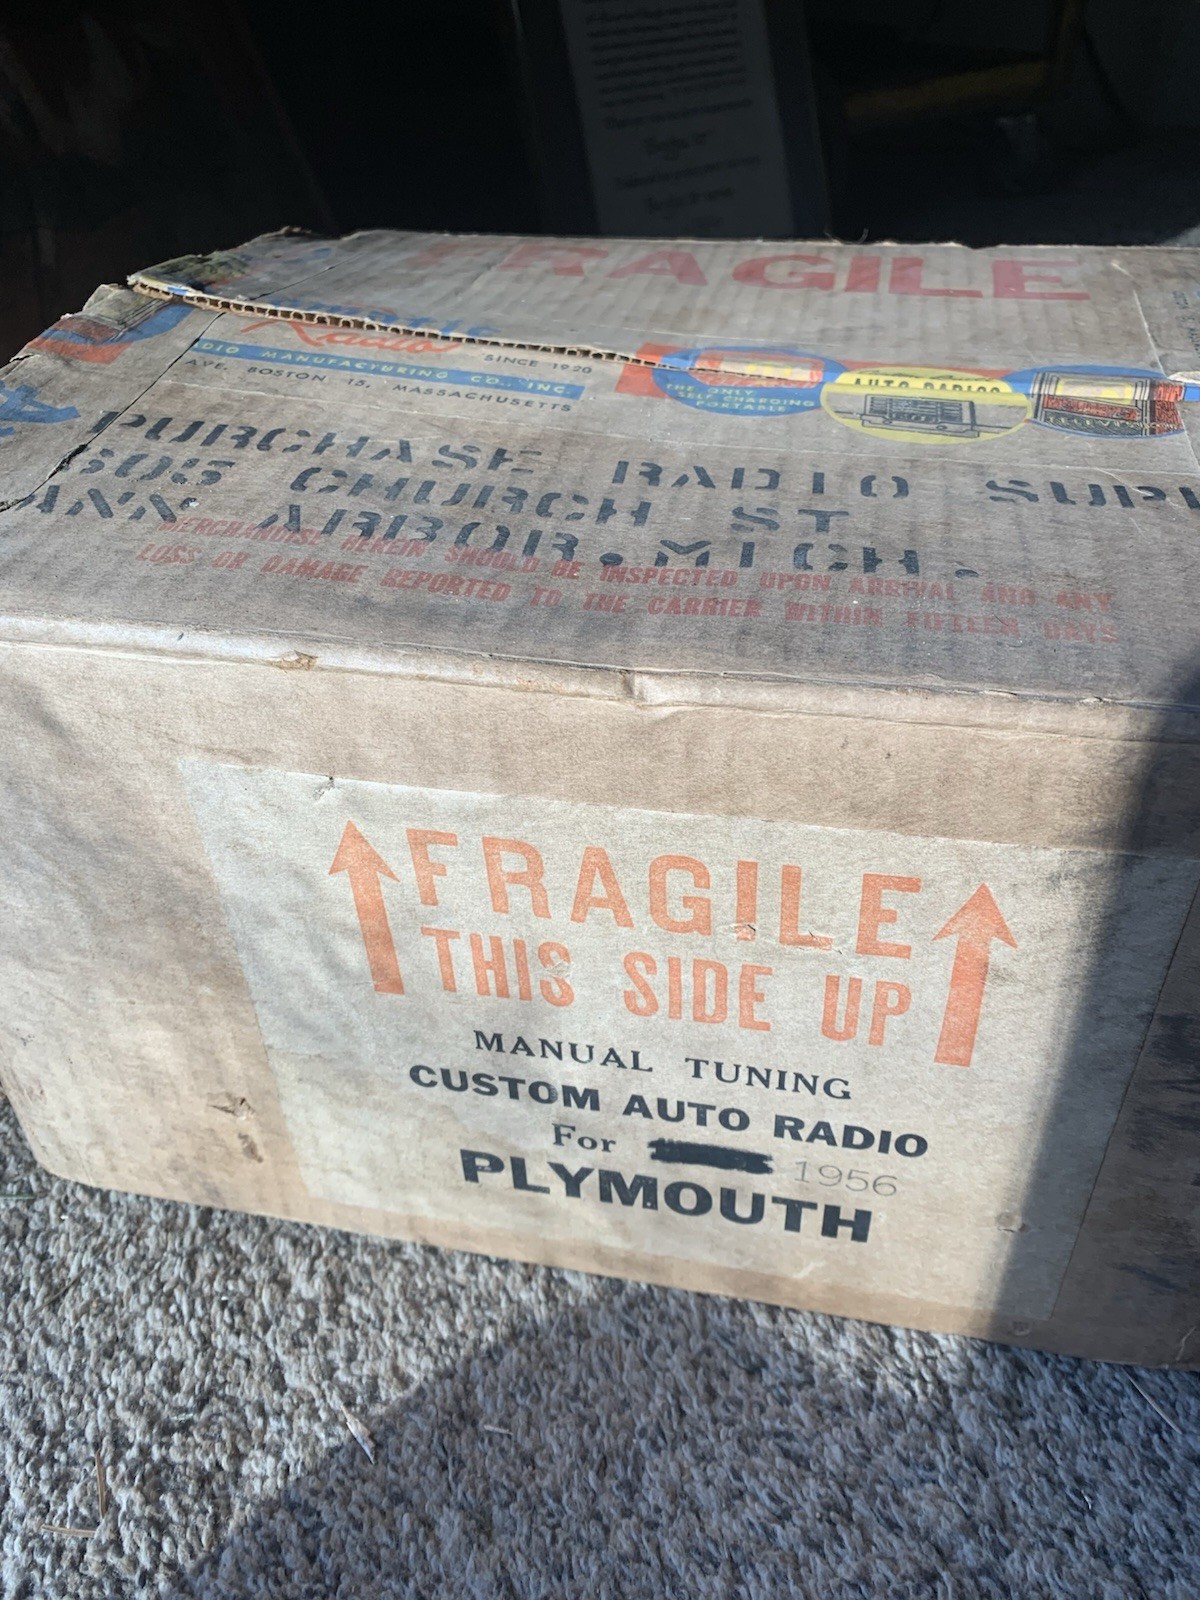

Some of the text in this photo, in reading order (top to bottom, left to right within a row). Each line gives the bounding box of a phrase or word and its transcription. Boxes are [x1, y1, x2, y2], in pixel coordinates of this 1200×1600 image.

[404, 242, 1091, 301] FRAGILE
[185, 358, 228, 371] AVE.
[247, 366, 327, 383] BOSTON
[392, 384, 573, 413] MASSACHUSETTS
[260, 350, 449, 379] MANUFACTURING
[484, 353, 593, 375] SINCE 1920
[666, 383, 755, 396] THE ONLY
[678, 391, 714, 400] SELF
[695, 400, 787, 413] PORTABLE
[87, 411, 542, 474] PURCHASE
[611, 460, 910, 499] RADIO
[289, 466, 652, 526] CHURCH
[730, 505, 850, 533] ST
[135, 542, 201, 566] LOSS
[211, 550, 252, 570] OR
[260, 554, 369, 584] DAMAGE
[379, 566, 512, 603] REPORTED
[529, 586, 563, 608] TO
[582, 591, 627, 614] THE
[647, 595, 763, 619] CARRIER
[783, 601, 884, 628] WITHIN
[1042, 618, 1119, 645] DAYS
[158, 515, 322, 547] MERCHANDISE
[340, 534, 430, 558] HEREIN
[444, 544, 541, 573] SHOULD
[550, 559, 585, 580] BE
[601, 562, 738, 588] INSPECTED
[760, 572, 832, 593] UPON
[980, 582, 1037, 606] AND
[405, 827, 922, 960] FRAGILE
[420, 925, 912, 1047] THIS SIDE UP
[473, 1029, 852, 1100] MANUAL TUNING
[408, 1064, 601, 1112] CUSTOM
[622, 1093, 751, 1132] AUTO
[773, 1113, 929, 1159] RADIO
[551, 1122, 899, 1197] For 1956
[459, 1148, 873, 1244] PLYMOUTH
